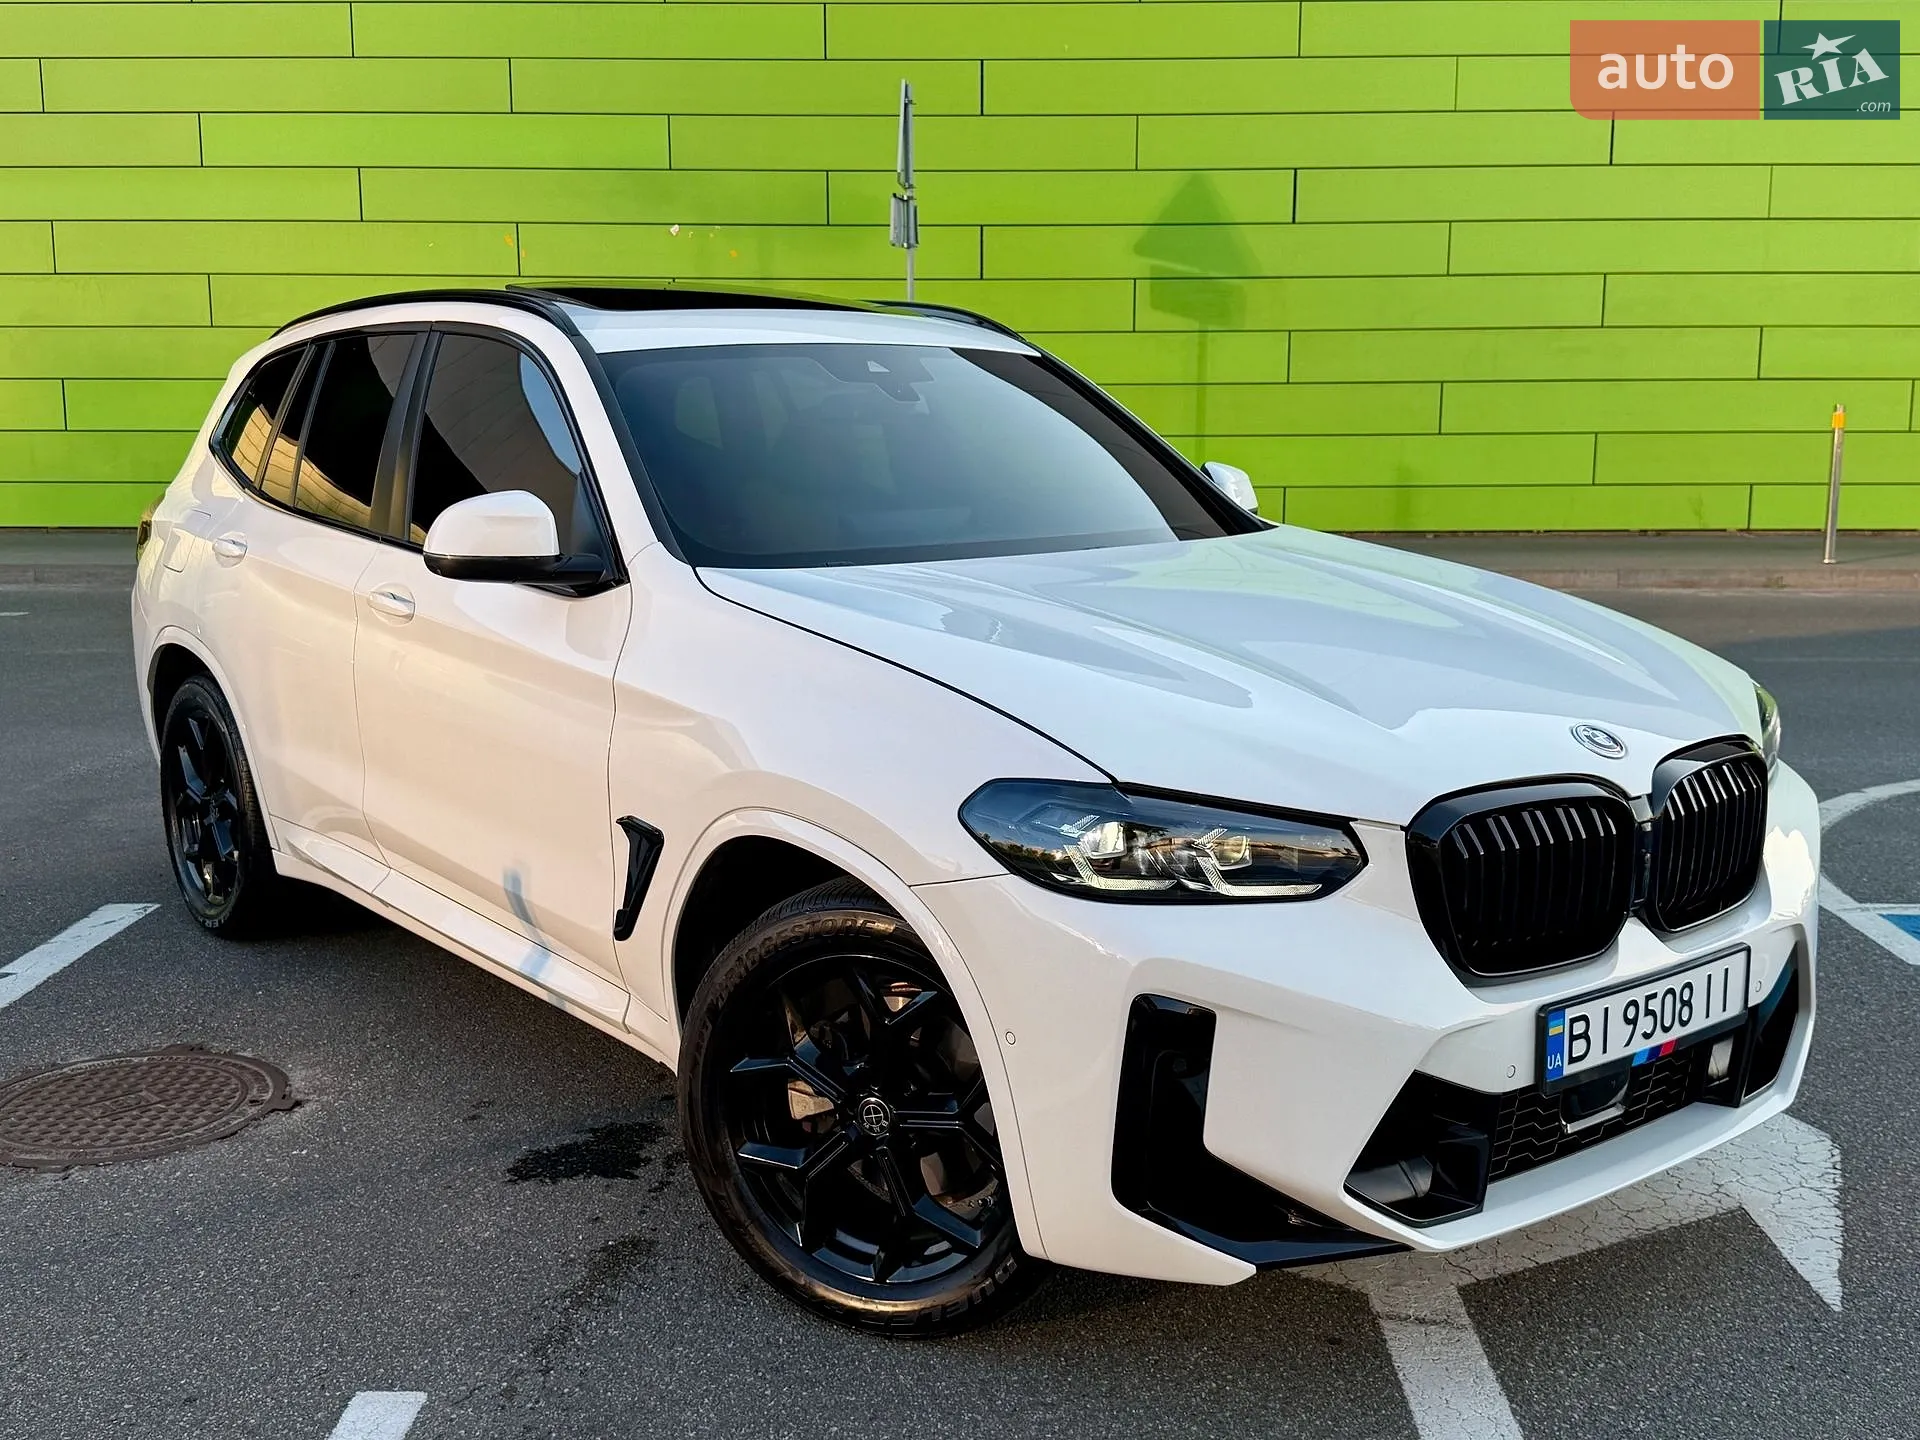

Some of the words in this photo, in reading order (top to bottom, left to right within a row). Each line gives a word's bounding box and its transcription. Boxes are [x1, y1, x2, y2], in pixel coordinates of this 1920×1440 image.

[1567, 1006, 1609, 1066] BI
[1622, 981, 1694, 1048] 9508
[1705, 967, 1729, 1019] II
[1547, 1052, 1562, 1070] UA
